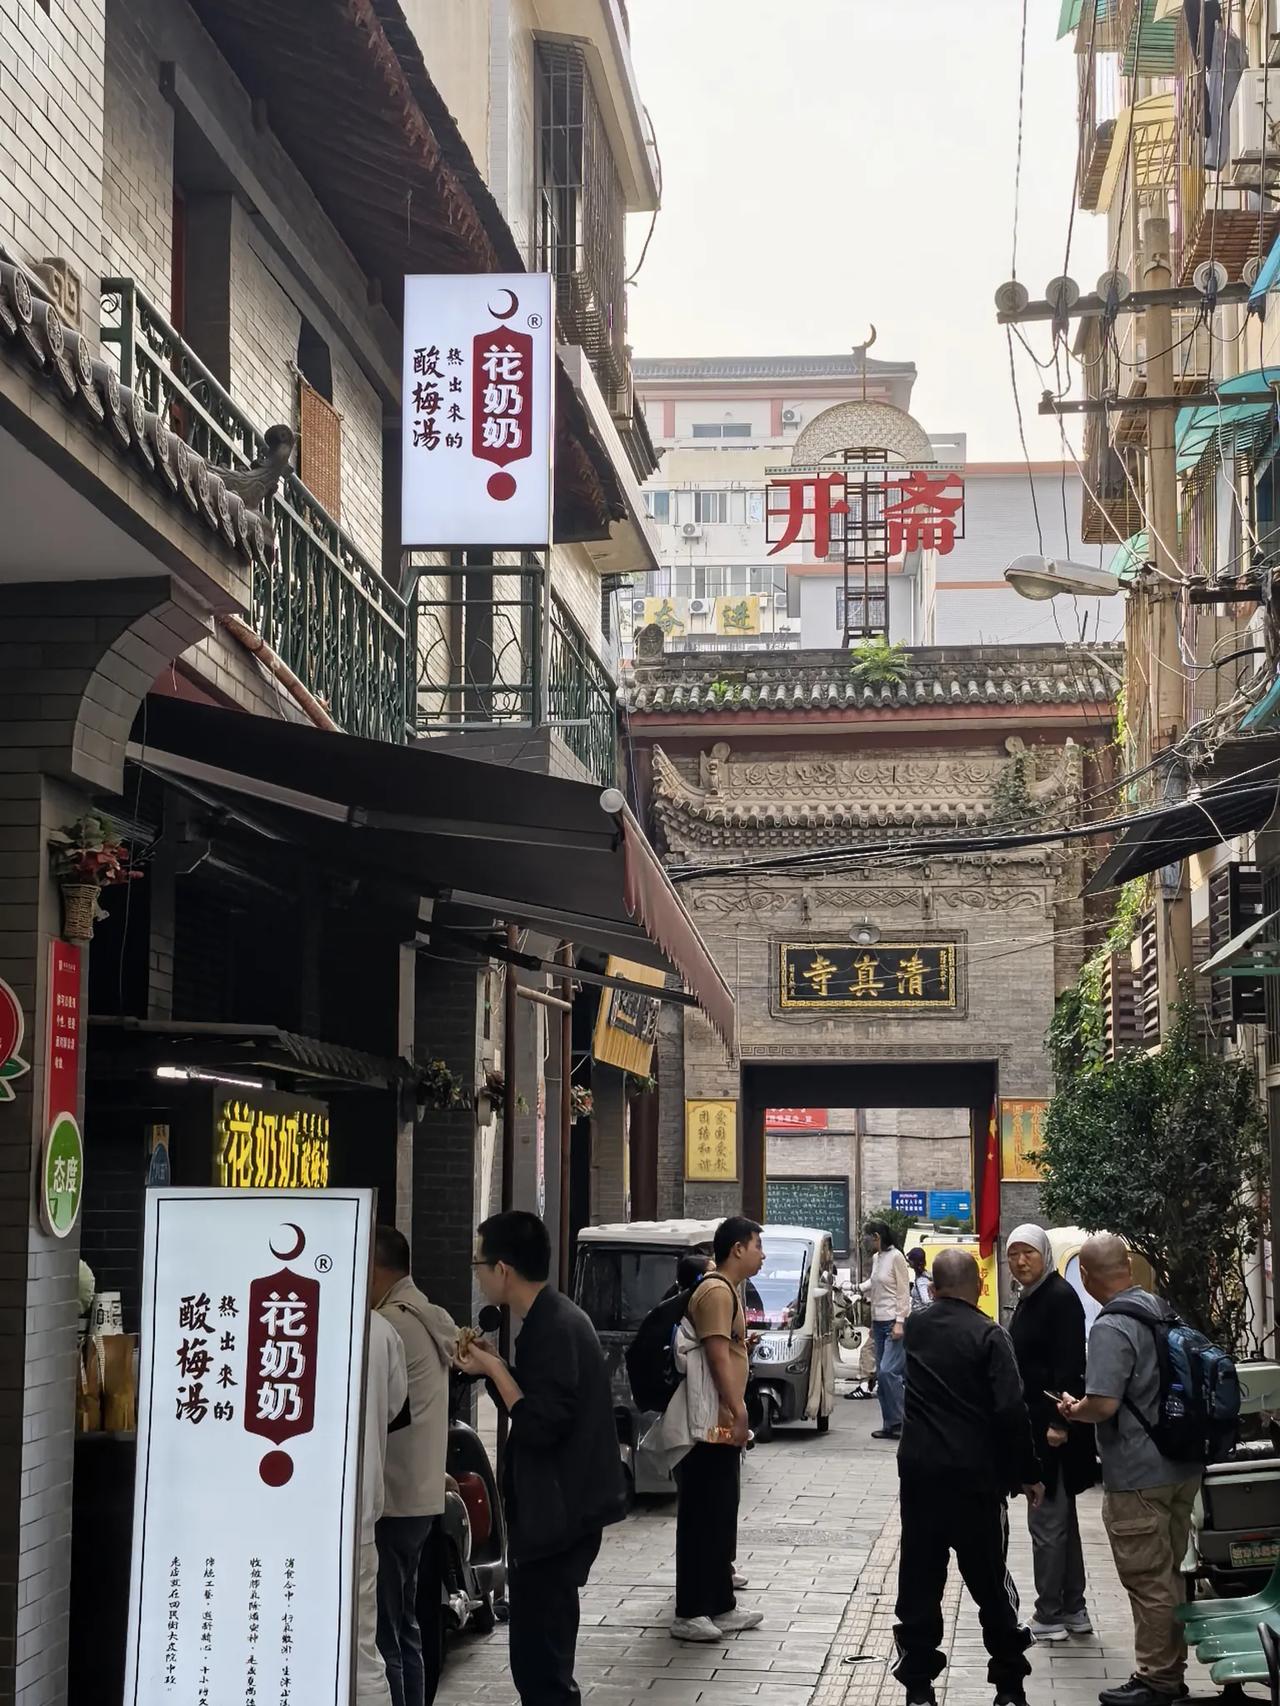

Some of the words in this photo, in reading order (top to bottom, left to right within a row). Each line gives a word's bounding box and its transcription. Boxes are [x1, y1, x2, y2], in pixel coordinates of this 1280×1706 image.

[411, 345, 445, 451] 酸梅湯
[481, 344, 524, 449] 花奶奶
[767, 471, 966, 557] 开斋
[53, 1156, 78, 1193] 态度
[175, 1292, 216, 1425] 酸梅湯
[256, 1291, 308, 1422] 花奶奶
